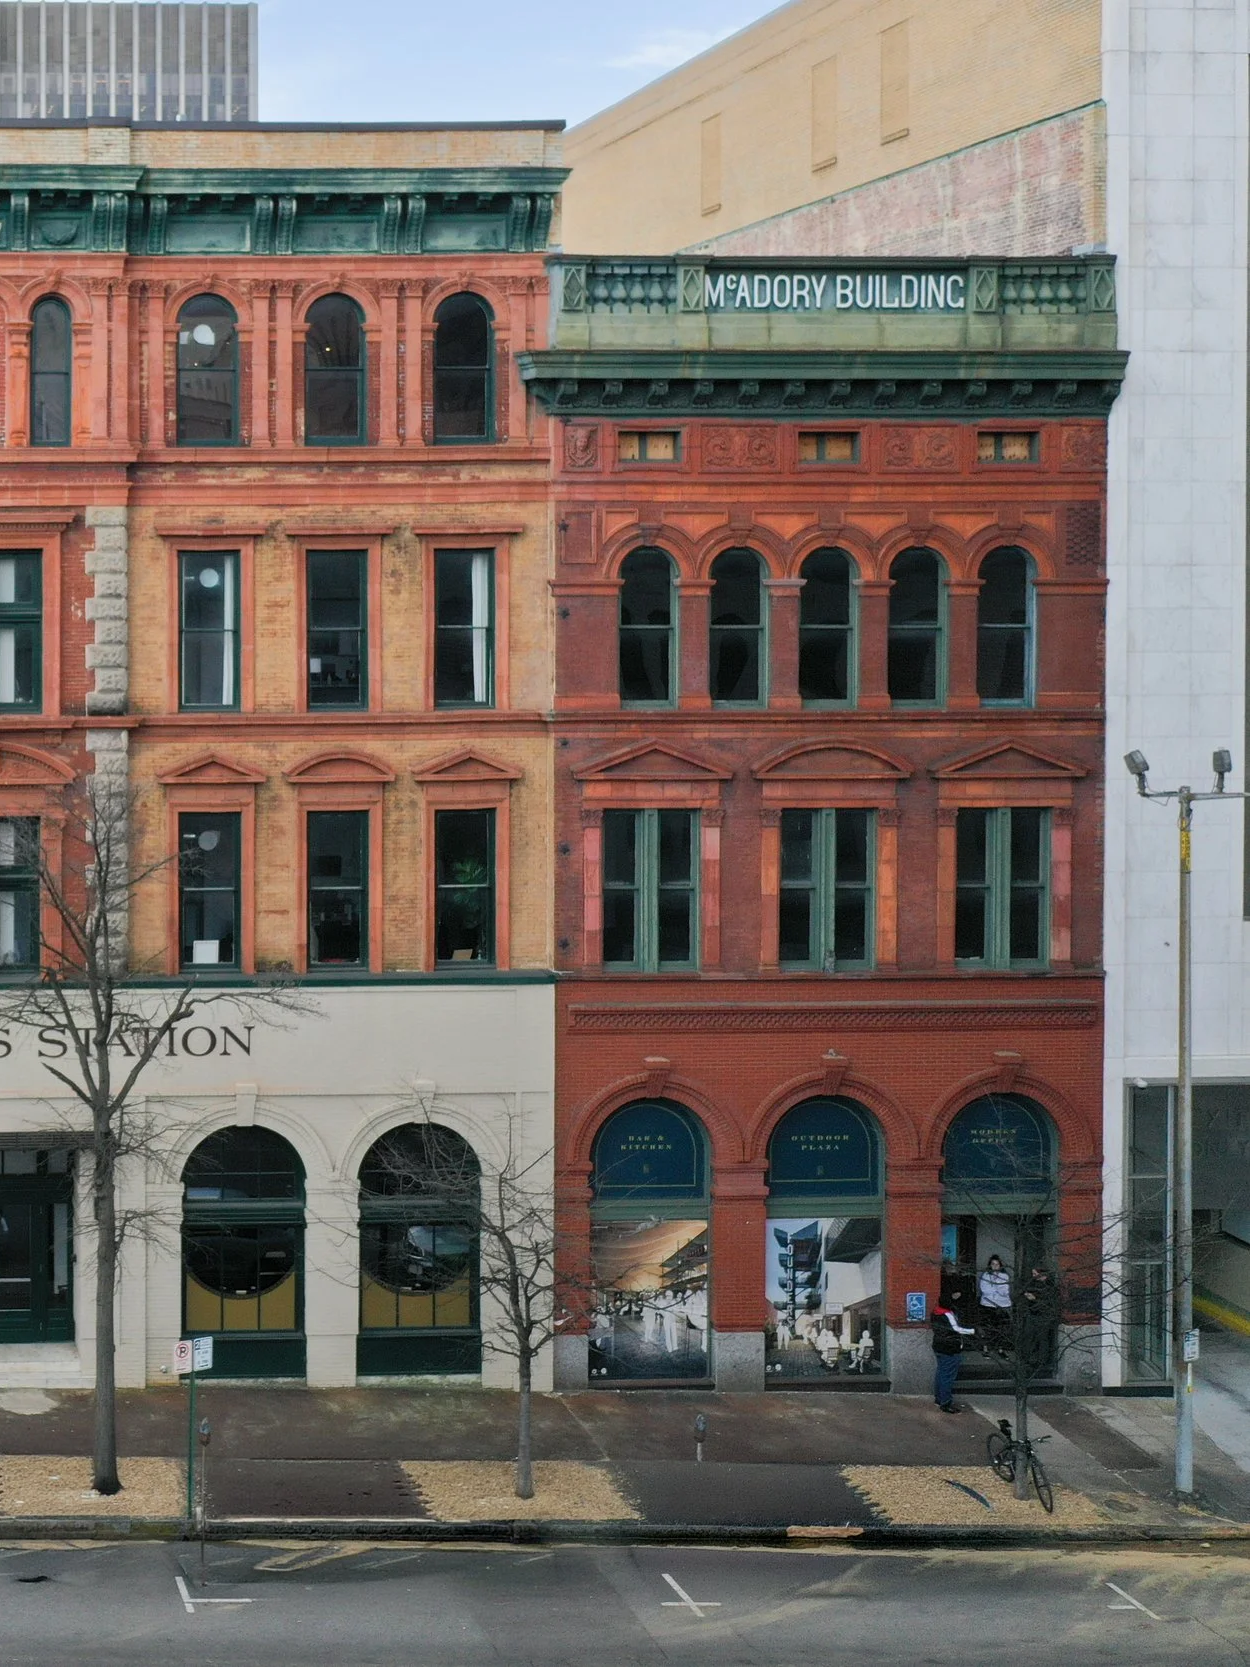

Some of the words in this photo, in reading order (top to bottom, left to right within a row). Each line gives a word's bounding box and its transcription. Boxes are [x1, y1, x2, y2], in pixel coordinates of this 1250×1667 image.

[836, 275, 965, 309] BUILDING
[37, 1025, 255, 1058] STATION
[791, 1134, 849, 1142] OUTDOOR
